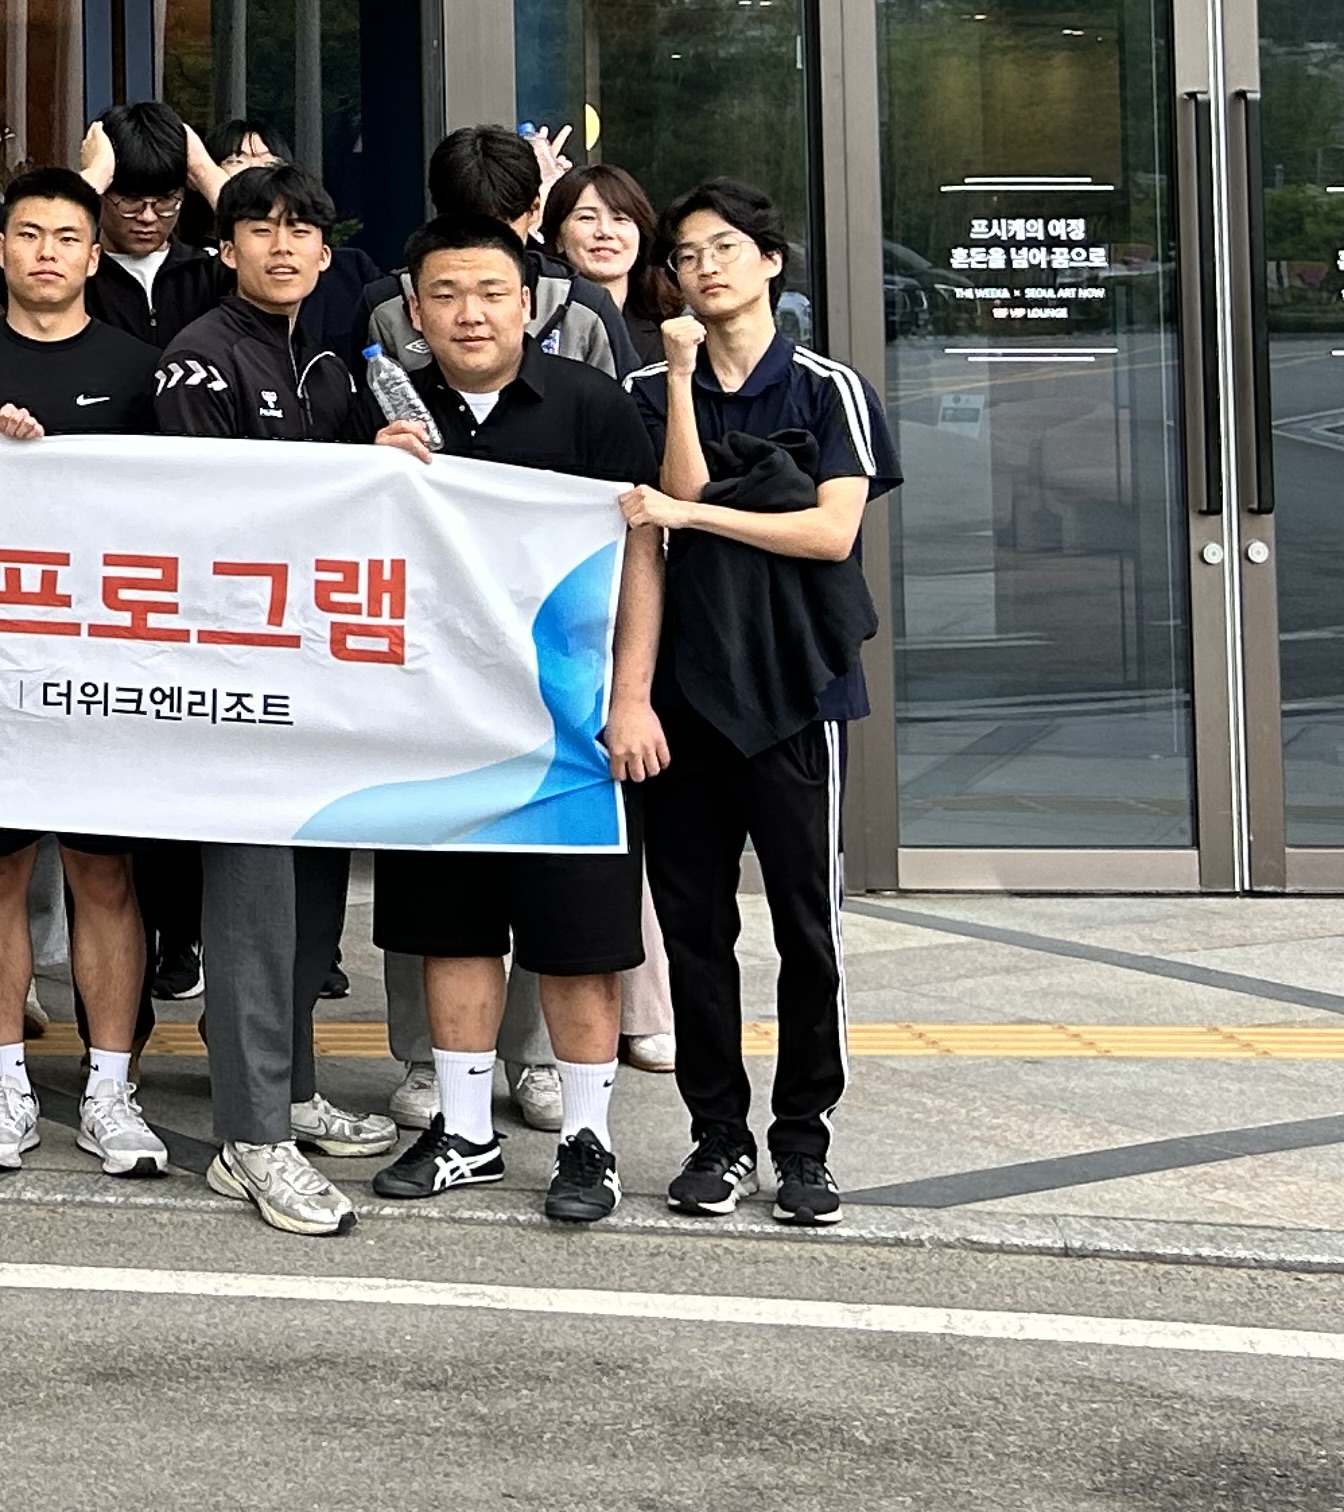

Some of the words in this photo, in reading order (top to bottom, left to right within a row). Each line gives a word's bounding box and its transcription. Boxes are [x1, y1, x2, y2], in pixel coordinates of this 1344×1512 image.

[1047, 218, 1085, 240] 여정
[1010, 247, 1047, 268] 넘어
[1051, 247, 1109, 268] 꿈으로
[42, 679, 294, 727] 더위크엔리조트
